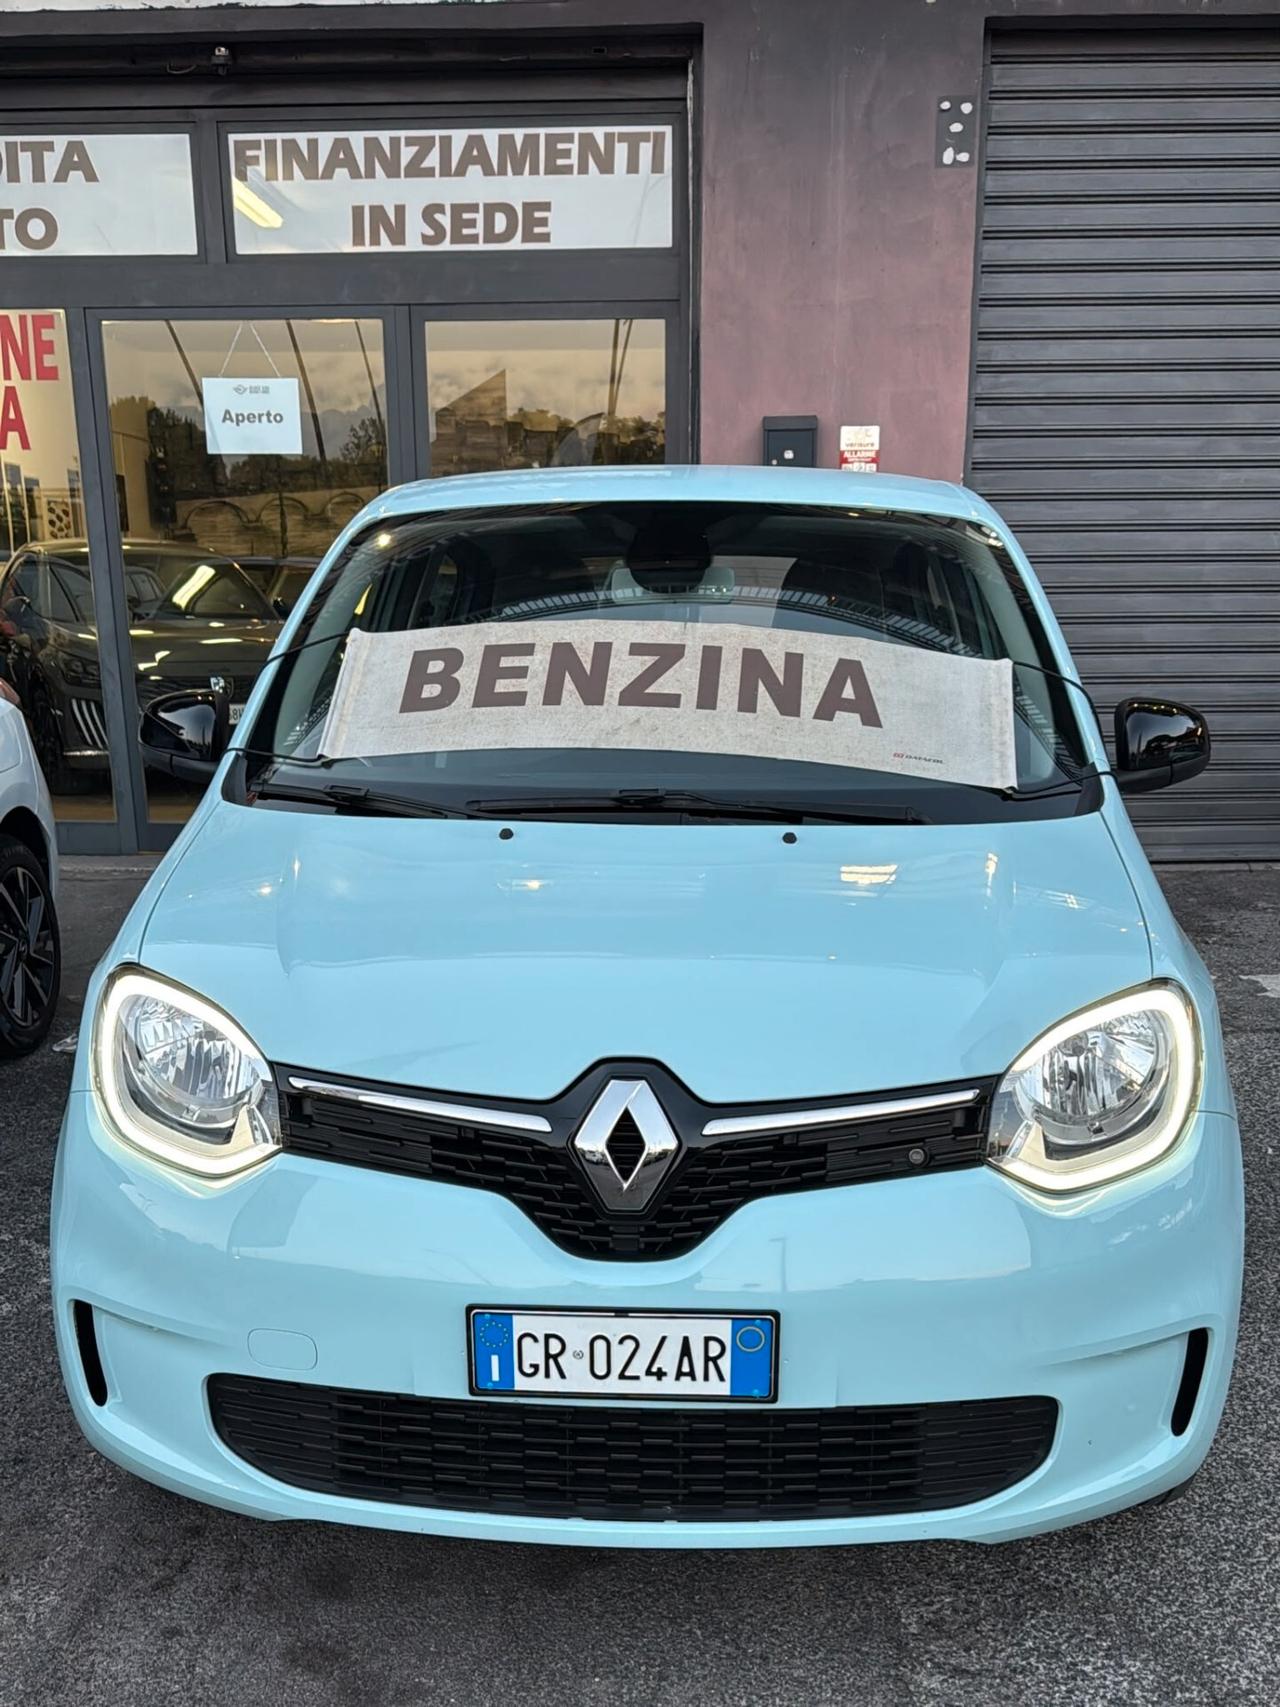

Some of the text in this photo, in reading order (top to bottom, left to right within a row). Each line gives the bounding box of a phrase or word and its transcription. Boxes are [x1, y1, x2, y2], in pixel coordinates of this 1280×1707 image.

[0, 137, 100, 185] ITA
[233, 131, 666, 181] FINANZIAMENTI
[352, 201, 552, 247] IN SEDE
[0, 314, 59, 381] NE
[222, 409, 284, 427] Aperto
[399, 641, 883, 728] BENZINA
[516, 1332, 727, 1383] GR 024AR
